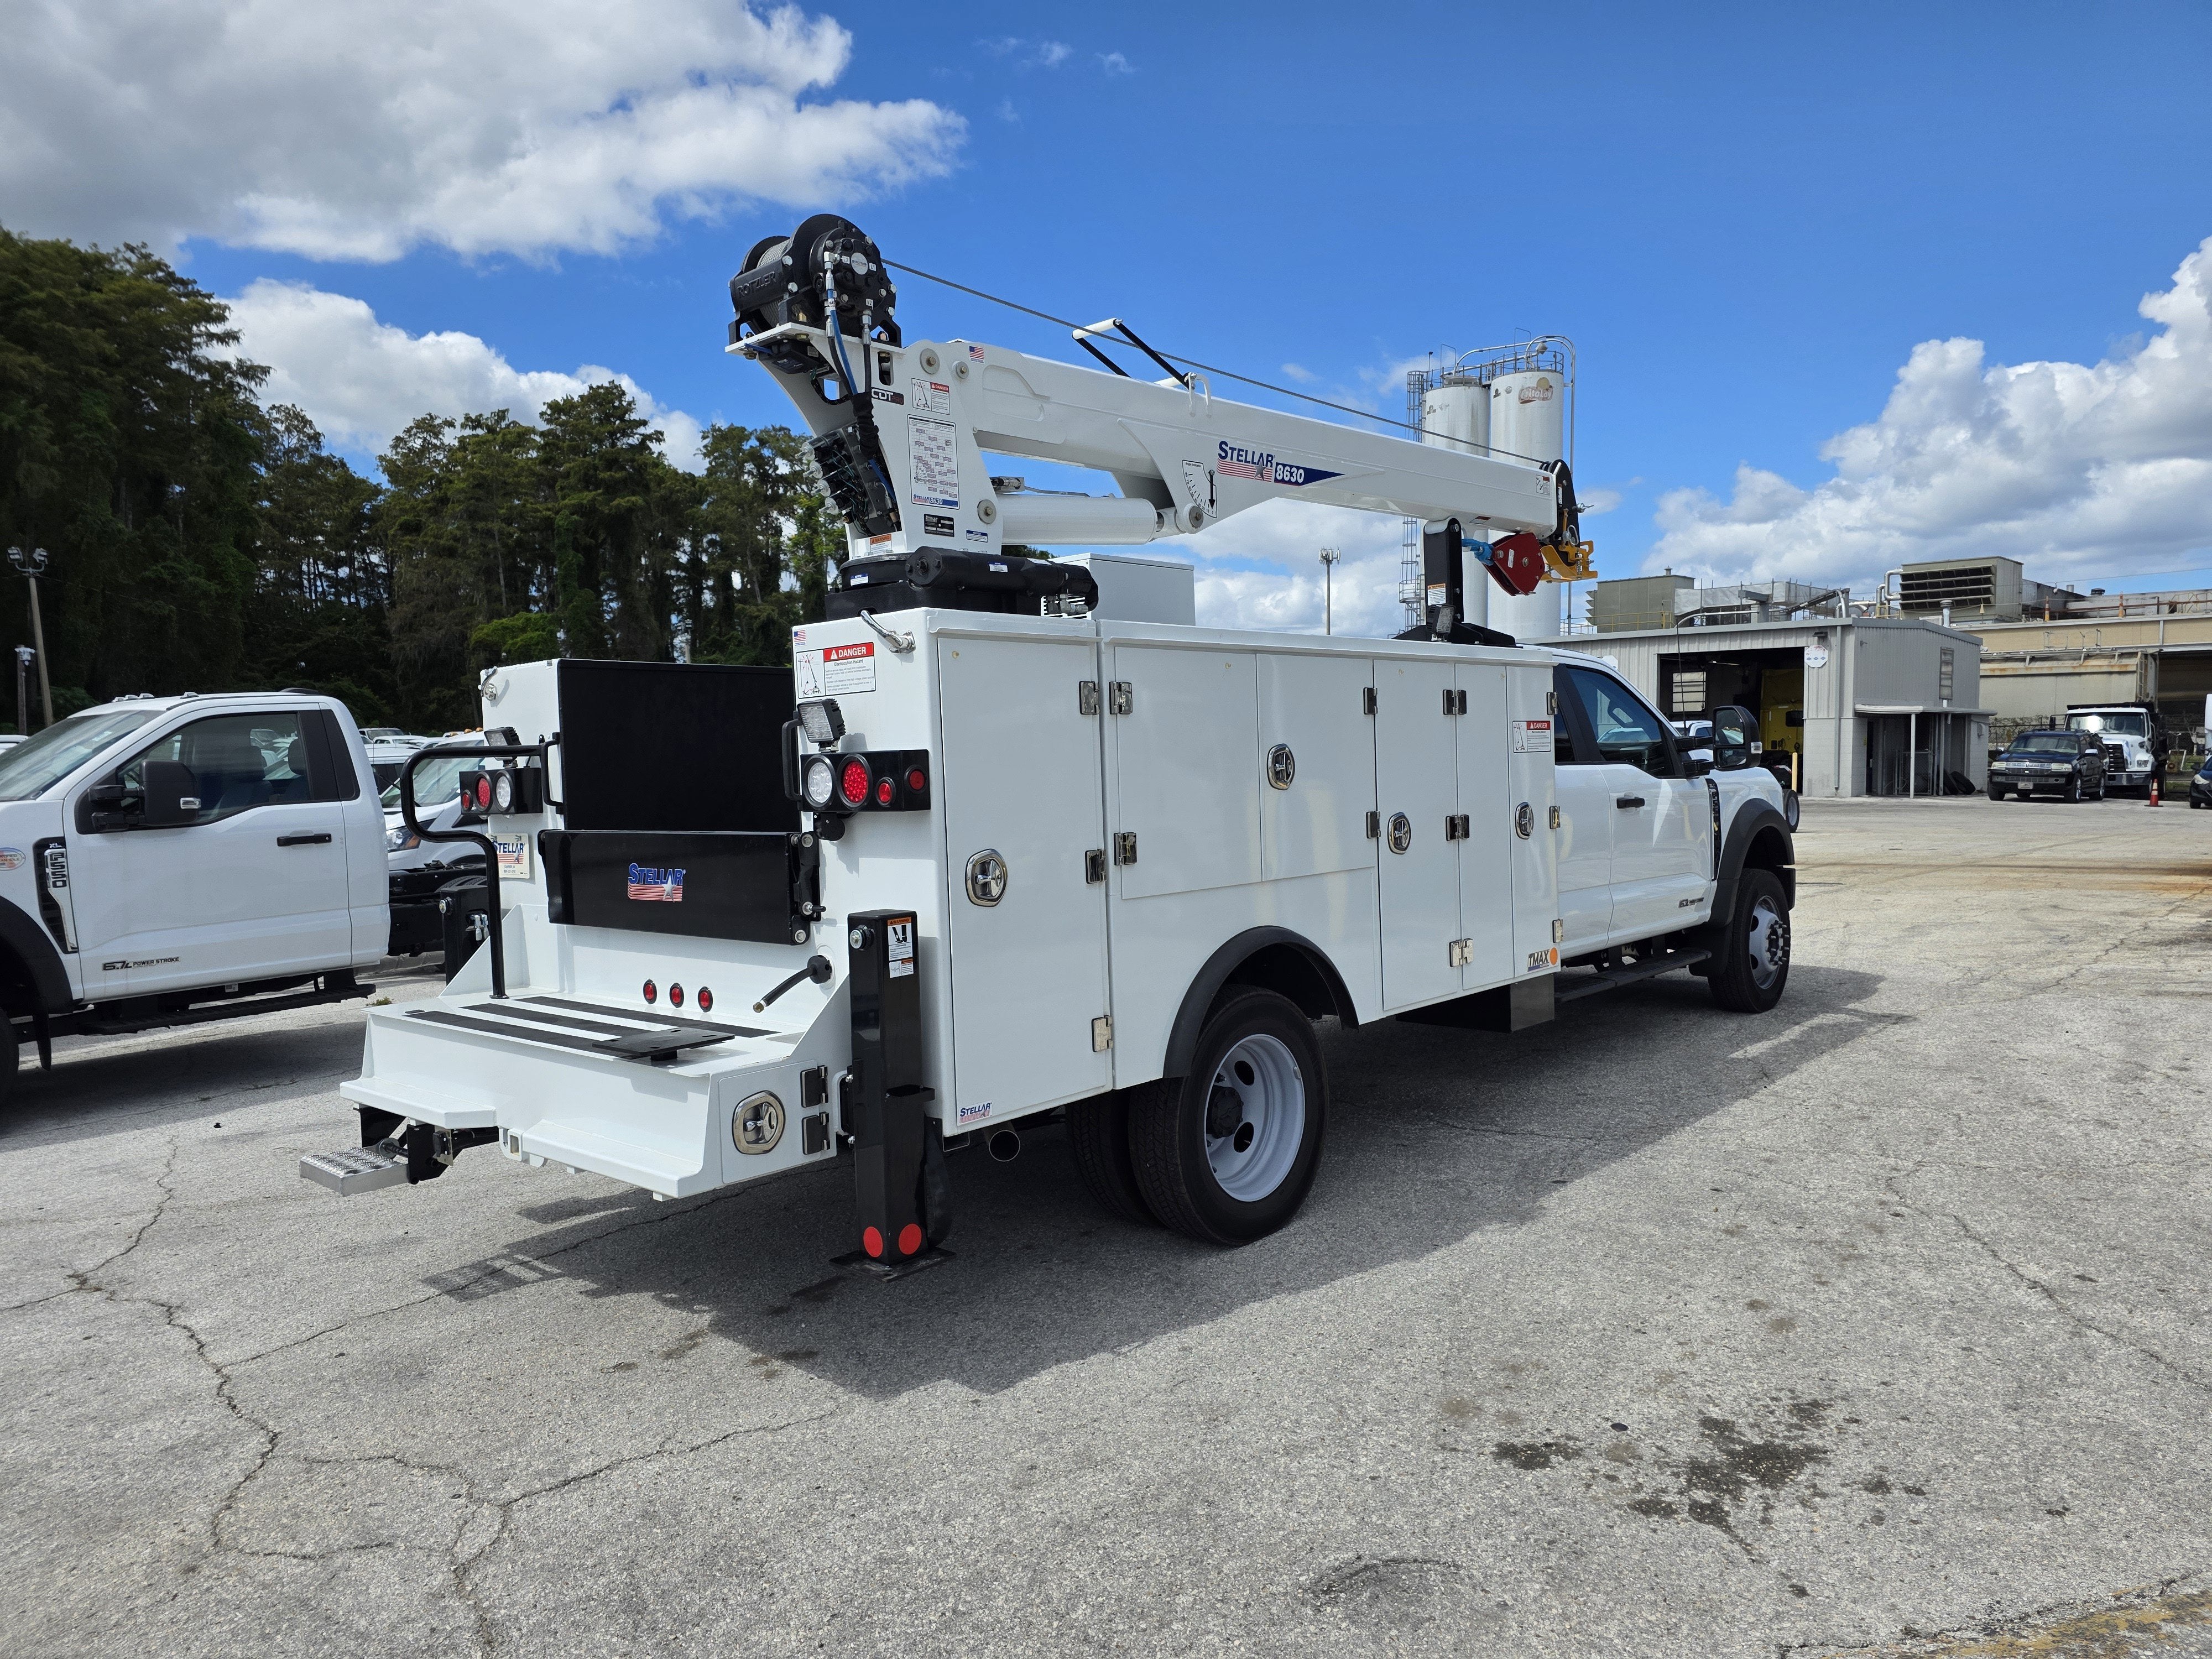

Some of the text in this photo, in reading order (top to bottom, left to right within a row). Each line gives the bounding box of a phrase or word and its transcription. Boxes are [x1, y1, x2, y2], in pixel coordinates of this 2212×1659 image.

[737, 271, 776, 297] ROTZLER
[1218, 441, 1304, 483] STELLAR 8630
[839, 646, 866, 658] DANGER
[628, 863, 682, 885] STELLAR
[103, 961, 132, 971] 6.7L
[1528, 951, 1548, 967] TMAX
[960, 1103, 990, 1117] STELLAR
